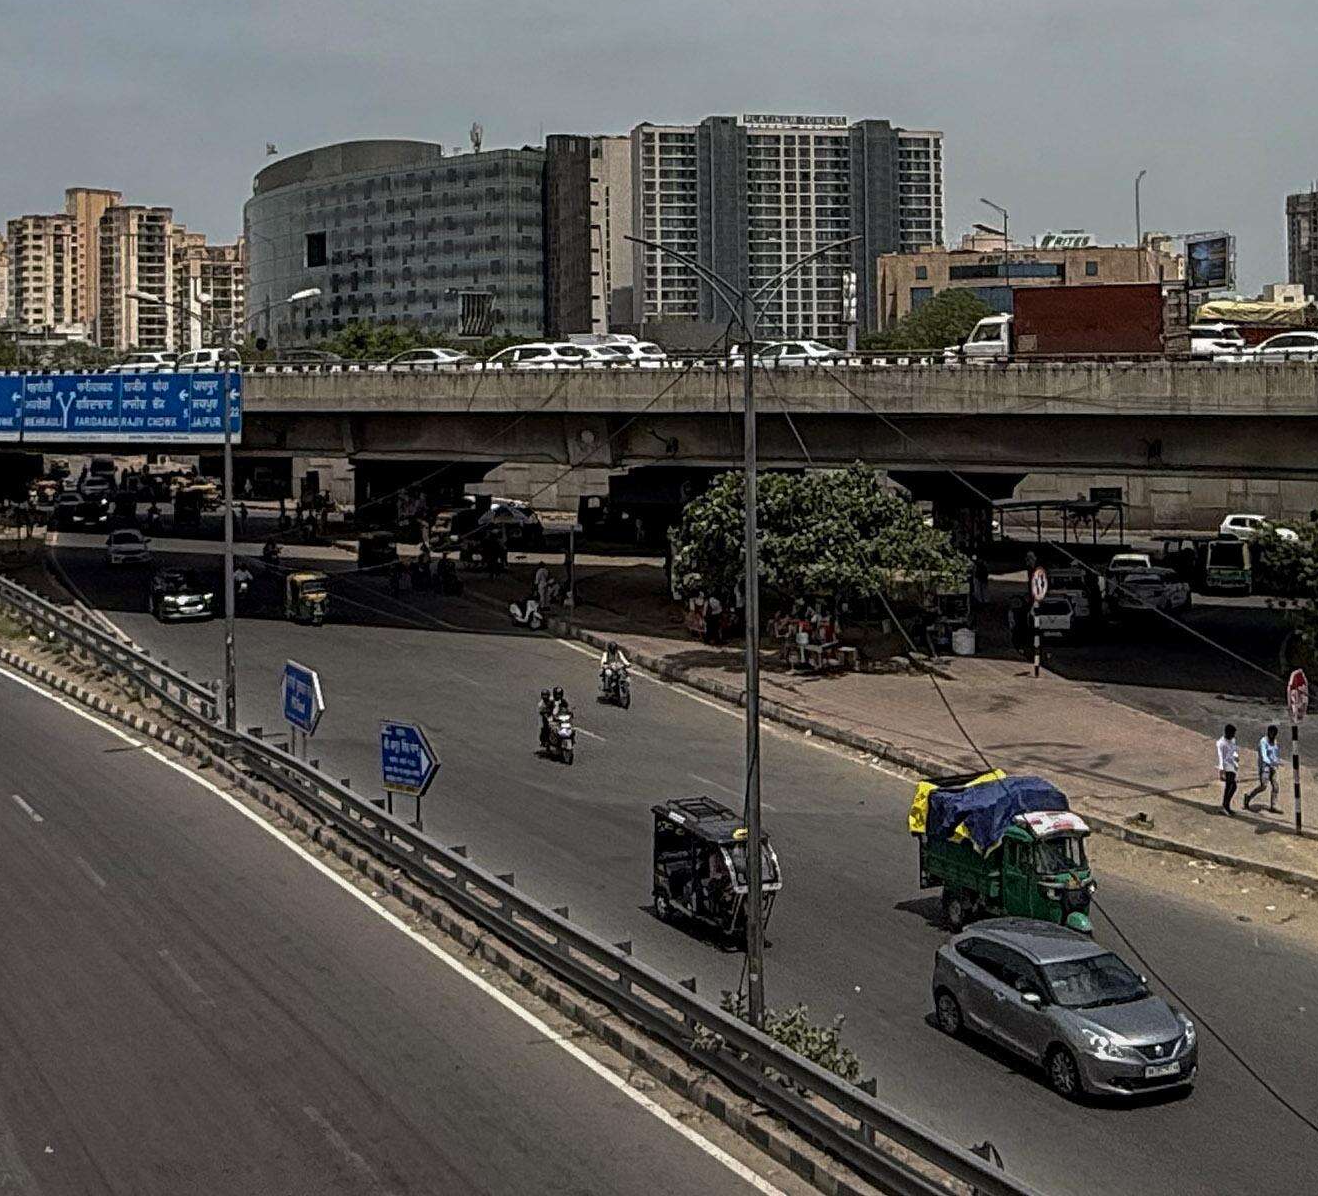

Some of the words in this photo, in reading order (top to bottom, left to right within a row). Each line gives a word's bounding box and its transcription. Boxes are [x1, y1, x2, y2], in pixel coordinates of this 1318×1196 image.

[74, 416, 119, 427] FARIDABAD
[121, 416, 144, 427] RAJIV
[147, 416, 177, 428] CHOWK
[191, 416, 221, 428] JAIPUR
